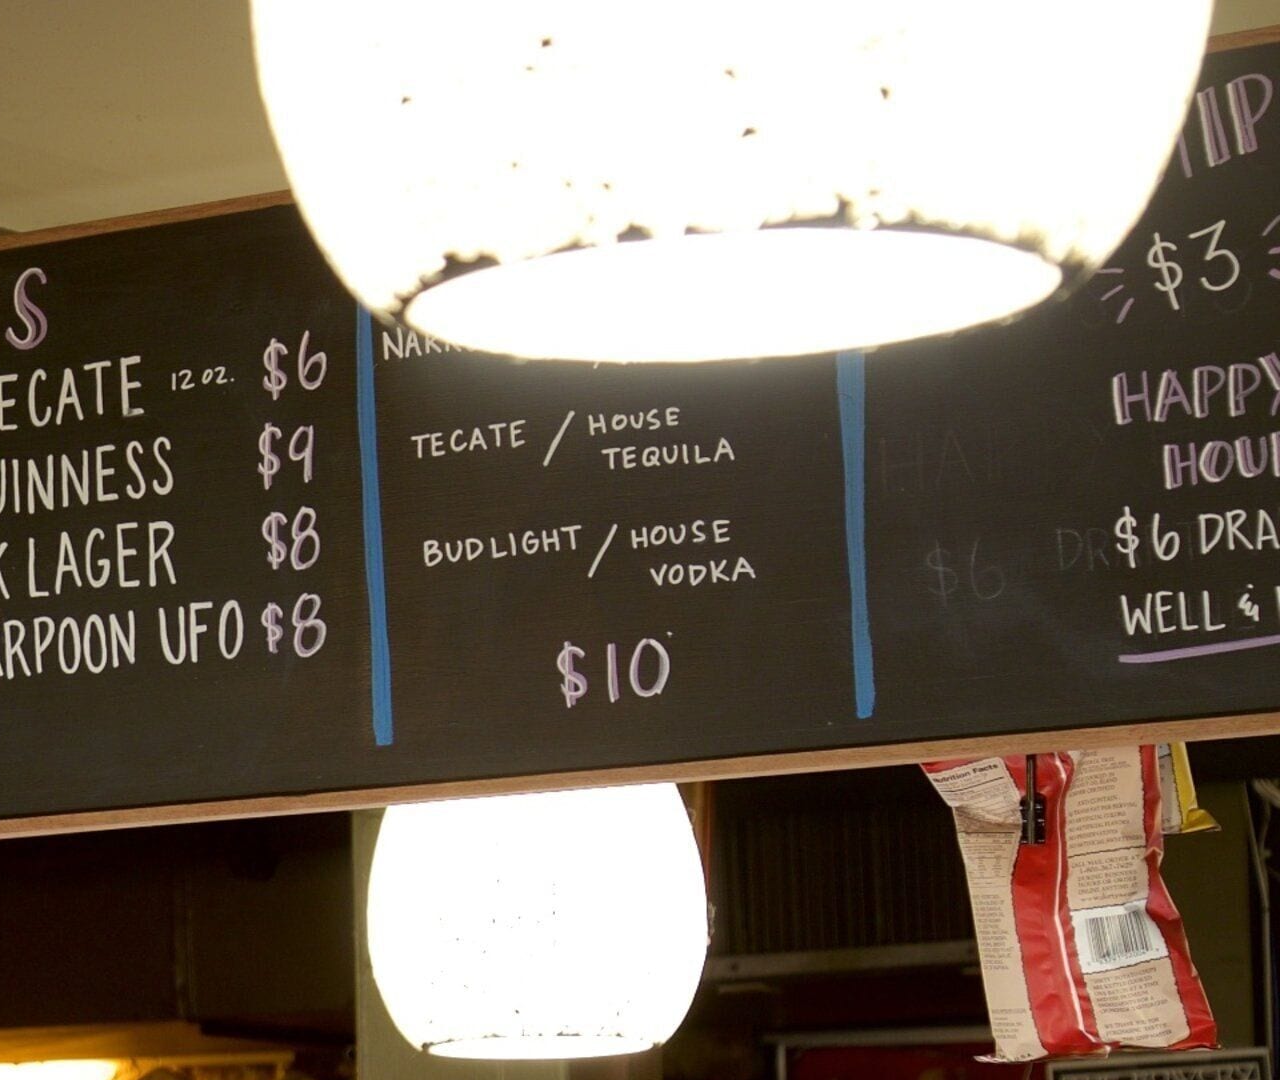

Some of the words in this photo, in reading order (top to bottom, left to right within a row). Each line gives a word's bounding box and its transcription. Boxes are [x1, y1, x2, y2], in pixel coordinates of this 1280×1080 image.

[1147, 219, 1240, 310] $3
[263, 330, 327, 400] $6
[257, 422, 314, 490] $9
[411, 420, 526, 459] TECATE
[589, 406, 681, 436] HOUSE
[602, 438, 735, 470] TEQUILA
[28, 521, 177, 598] LAGER
[261, 507, 320, 571] $8
[631, 520, 731, 549] HOUSE
[1115, 506, 1180, 568] $6
[650, 557, 756, 586] VODKA
[159, 600, 244, 664] UFO
[261, 593, 326, 659] $8
[1121, 590, 1225, 635] WELL
[557, 638, 670, 708] $10
[973, 763, 998, 774] Facts
